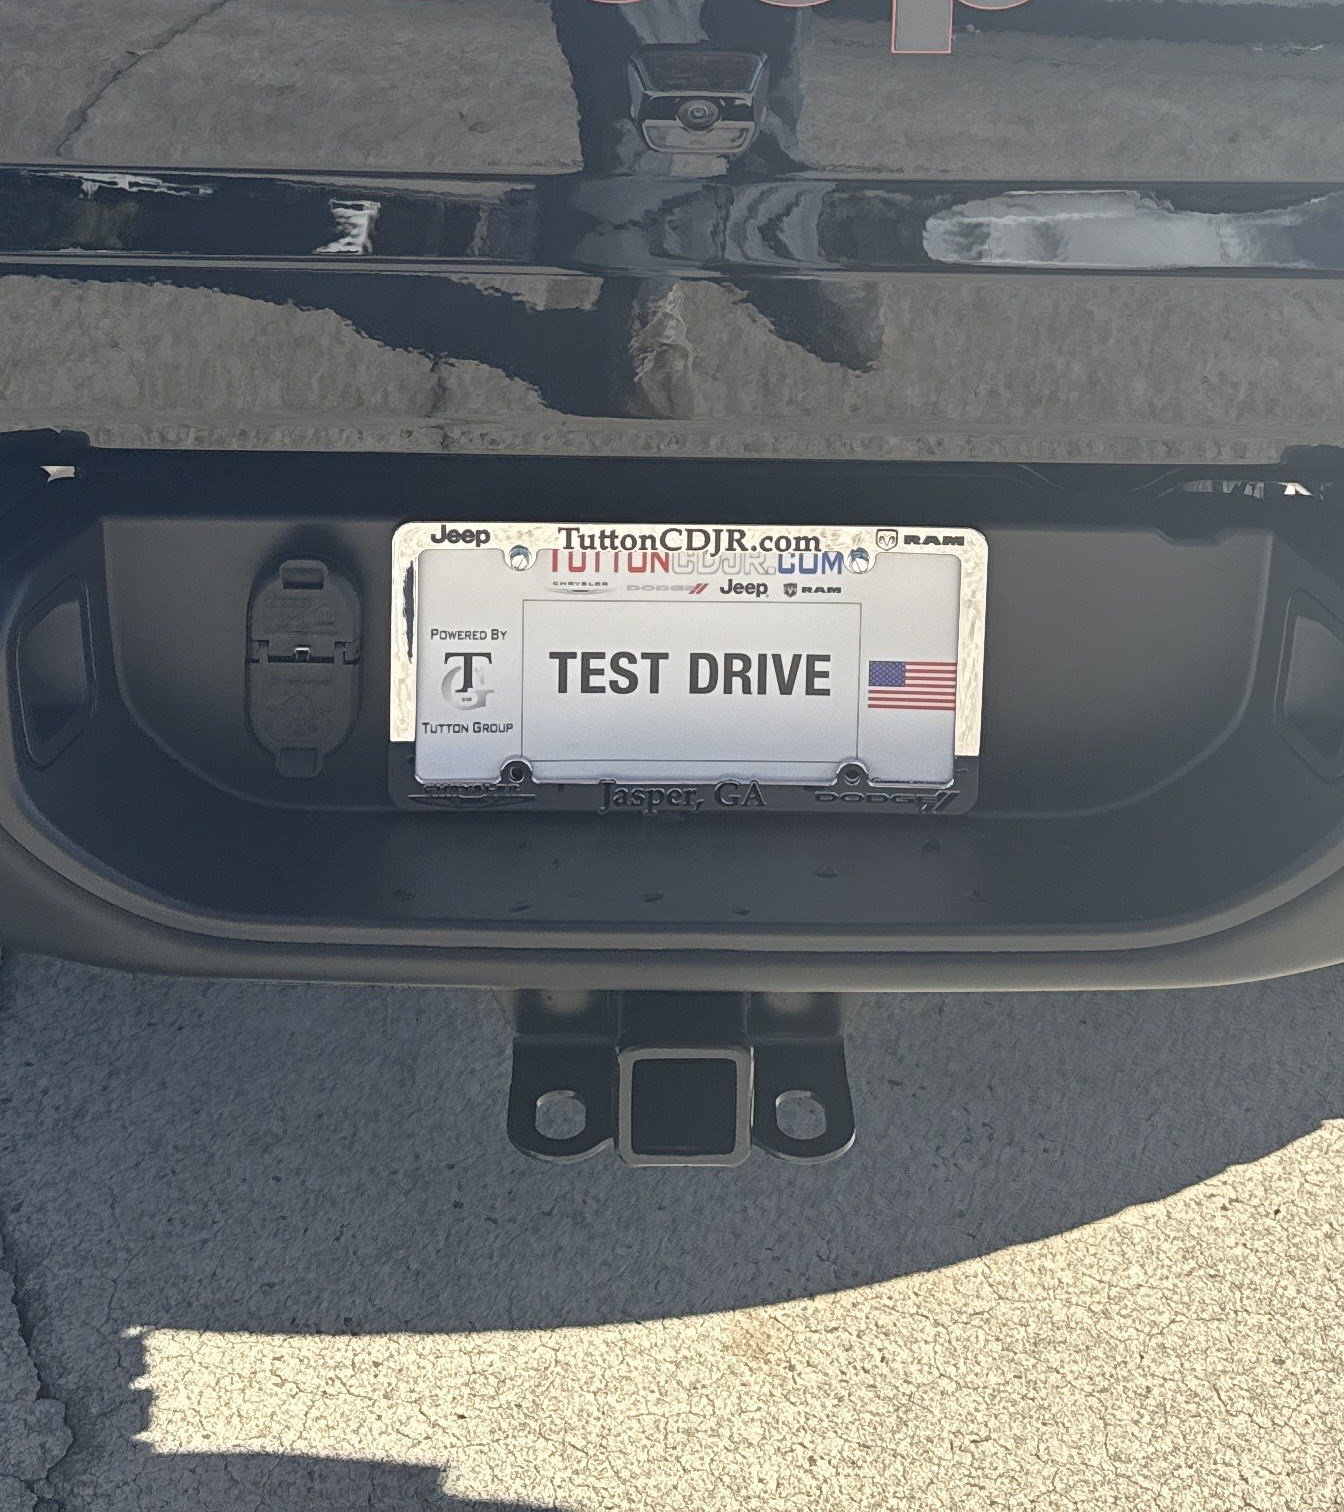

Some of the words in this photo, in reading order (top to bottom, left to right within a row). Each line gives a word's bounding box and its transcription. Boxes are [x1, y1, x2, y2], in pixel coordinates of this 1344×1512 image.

[430, 524, 491, 548] Jeep
[557, 527, 823, 558] TuttonCDJR.com
[903, 534, 965, 547] RAM
[720, 579, 769, 598] Jeep
[801, 586, 842, 594] RAM
[549, 651, 669, 695] TEST
[689, 652, 831, 696] DRIVE
[597, 778, 705, 816] Jasper,
[714, 778, 768, 807] GA
